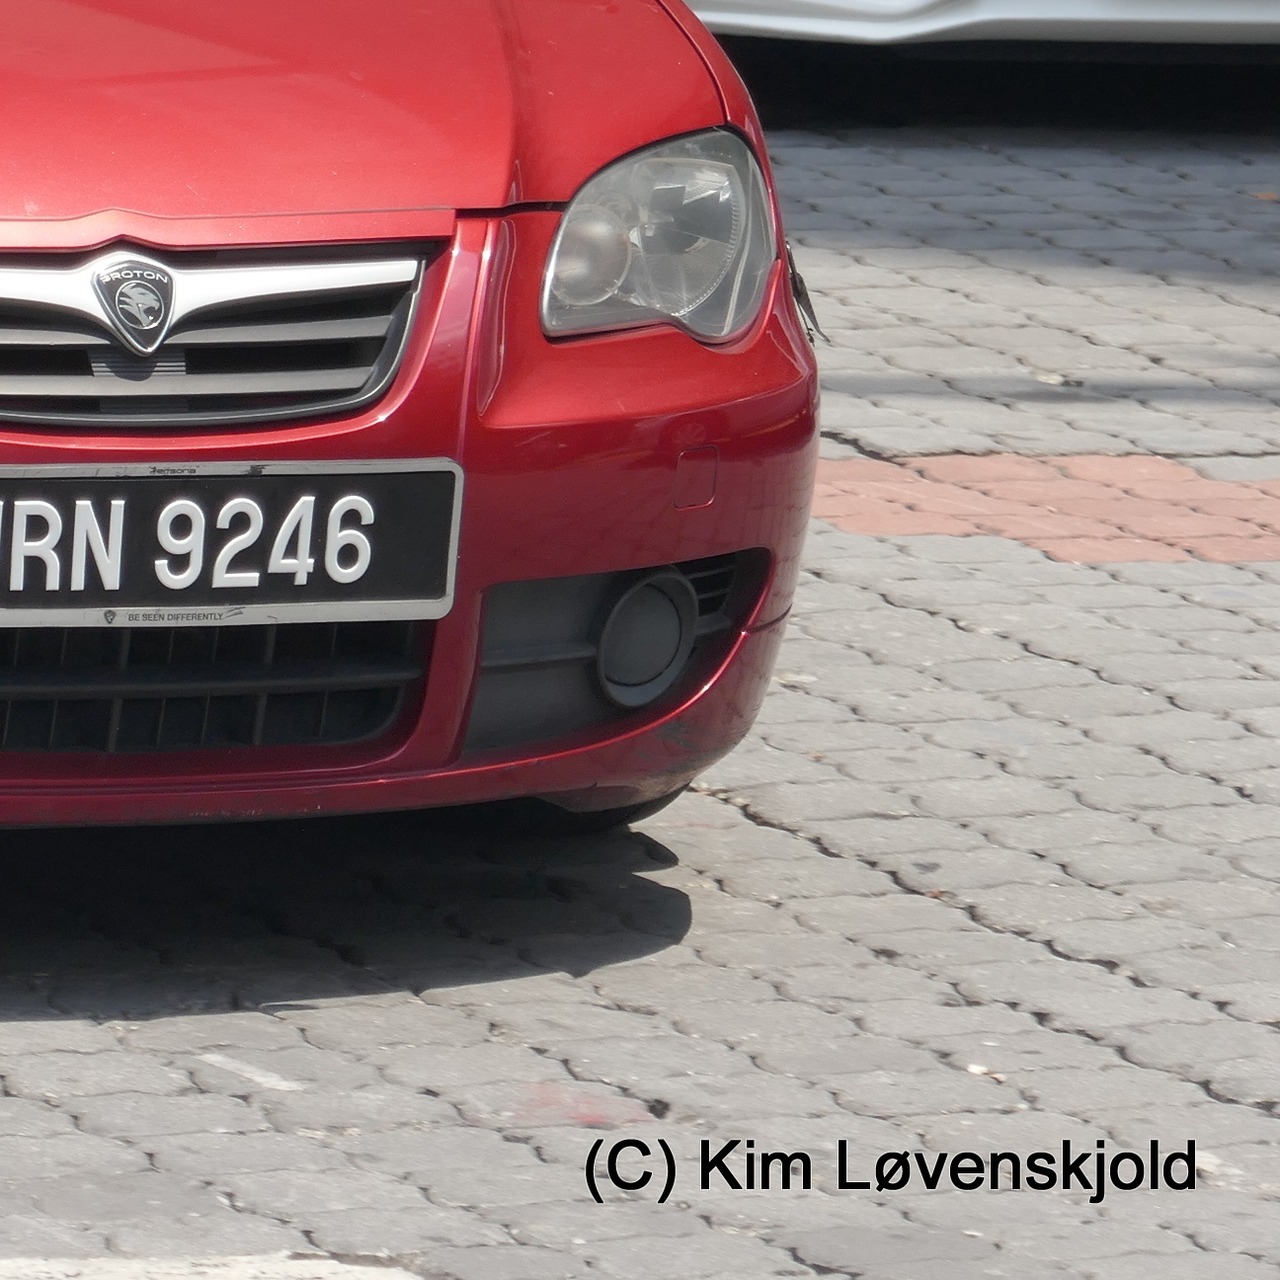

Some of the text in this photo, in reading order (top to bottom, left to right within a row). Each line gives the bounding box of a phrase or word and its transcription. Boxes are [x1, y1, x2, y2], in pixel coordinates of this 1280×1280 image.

[99, 269, 169, 285] PROTON
[153, 494, 375, 590] 9246
[128, 612, 224, 622] BE SEEN DIFFERENTLY
